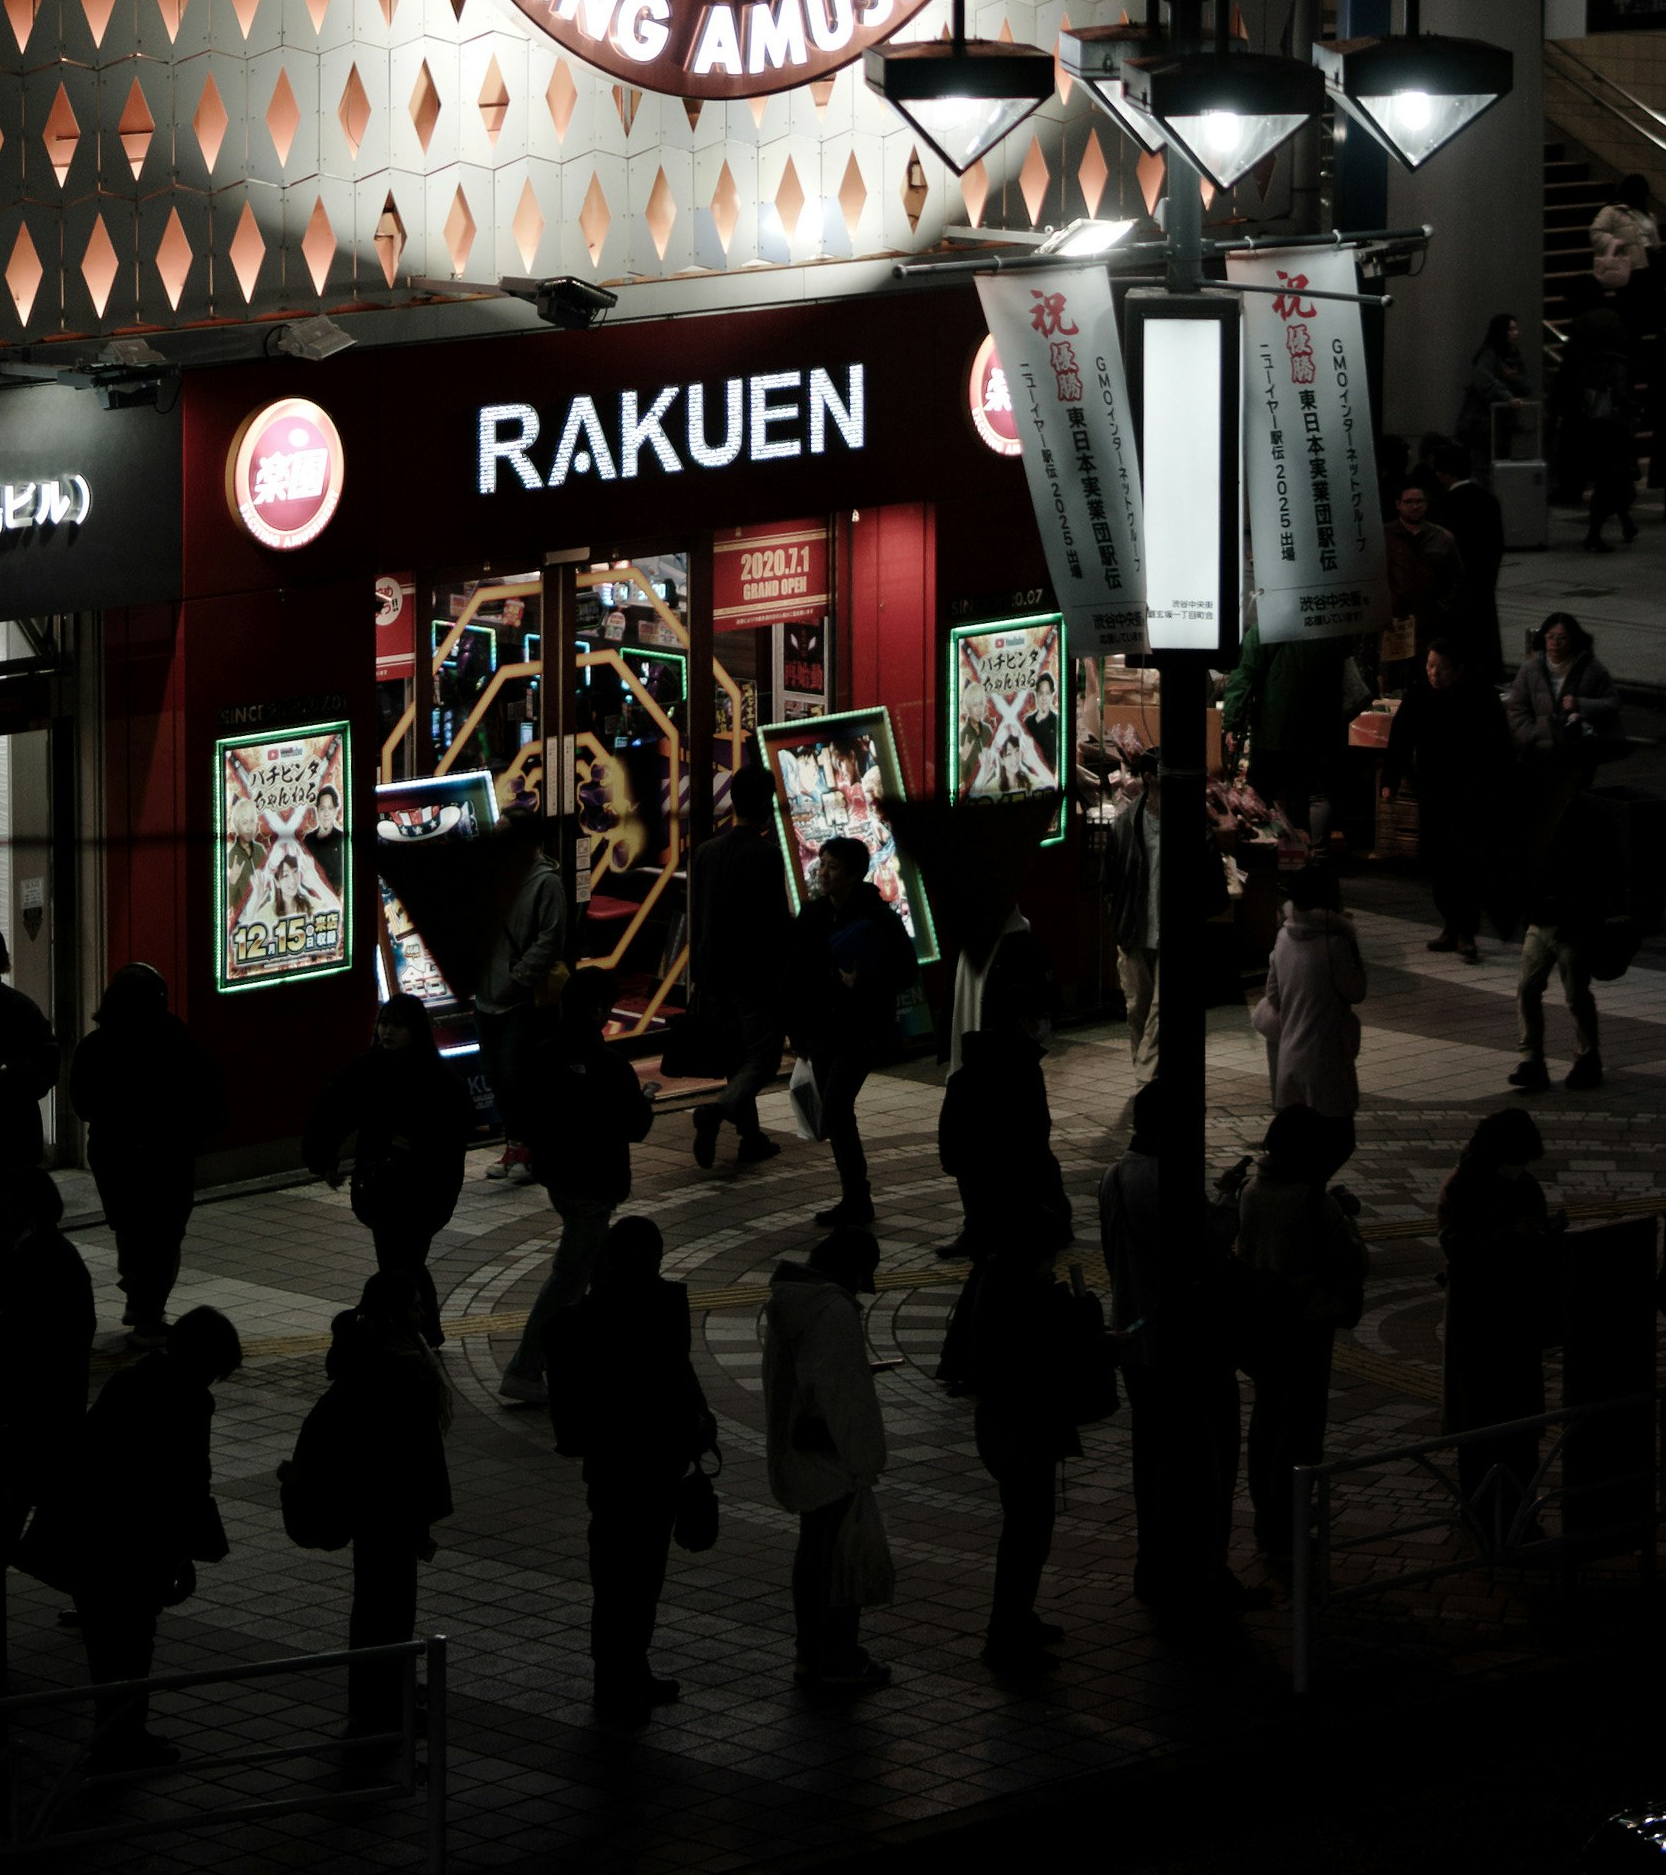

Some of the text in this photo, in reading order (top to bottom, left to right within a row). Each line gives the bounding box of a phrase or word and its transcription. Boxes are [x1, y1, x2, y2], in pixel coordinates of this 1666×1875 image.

[1029, 290, 1079, 338] 祝
[983, 366, 1013, 412] 楽
[1049, 340, 1083, 402] 優勝
[475, 362, 867, 496] RAKUEN
[1272, 270, 1338, 572] 祝 優勝 東日本実業団駅伝
[253, 447, 329, 506] 楽園
[740, 545, 810, 581] 2020.7.1
[743, 575, 808, 601] GRAND OPEN
